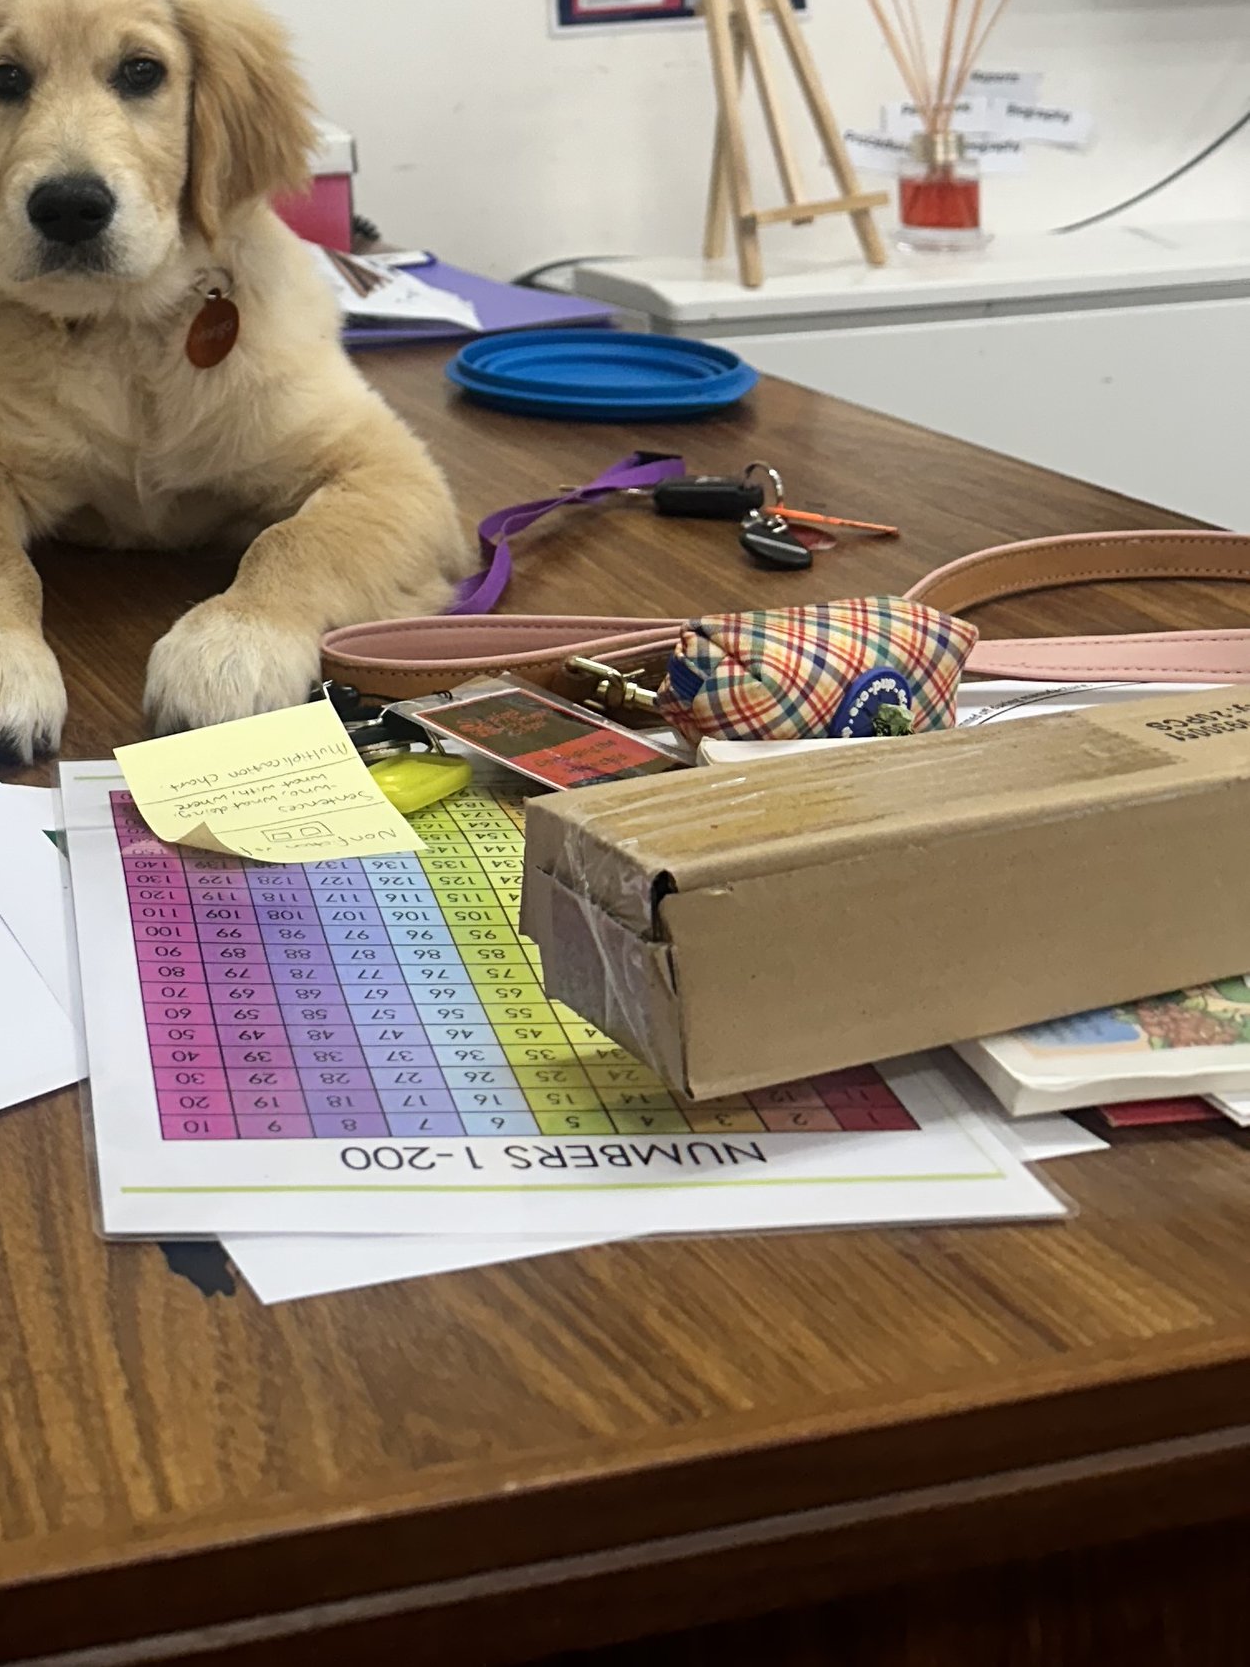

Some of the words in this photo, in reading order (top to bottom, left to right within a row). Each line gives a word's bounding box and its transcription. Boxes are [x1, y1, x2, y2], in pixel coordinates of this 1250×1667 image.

[228, 742, 348, 779] Multiplication
[282, 773, 328, 787] what
[174, 793, 227, 811] where
[233, 796, 278, 810] what
[278, 790, 375, 813] Sentences
[146, 927, 181, 937] 100
[216, 929, 242, 938] 99
[279, 929, 305, 939] 98
[345, 930, 369, 939] 97
[406, 930, 433, 940] 96
[469, 930, 496, 939] 95
[155, 947, 181, 956] 90
[220, 948, 246, 958] 89
[284, 949, 310, 959] 88
[351, 950, 375, 959] 87
[414, 950, 440, 959] 86
[478, 949, 505, 959] 85
[158, 967, 185, 977] 80
[225, 968, 249, 978] 79
[290, 969, 314, 979] 78
[358, 969, 382, 979] 77
[422, 969, 448, 978] 76
[487, 969, 514, 978] 75
[162, 987, 187, 998] 70
[229, 989, 254, 999] 69
[295, 989, 321, 999] 68
[365, 989, 388, 999] 67
[430, 989, 455, 998] 66
[496, 988, 522, 998] 65
[165, 1008, 191, 1019] 60
[234, 1009, 259, 1019] 59
[302, 1009, 327, 1019] 58
[372, 1009, 395, 1019] 57
[438, 1009, 463, 1019] 56
[505, 1008, 531, 1018] 55
[168, 1030, 195, 1040] 50
[239, 1030, 265, 1040] 49
[307, 1030, 334, 1040] 48
[379, 1030, 403, 1040] 47
[446, 1030, 473, 1039] 46
[515, 1029, 542, 1038] 45
[172, 1051, 200, 1062] 40
[244, 1052, 271, 1062] 39
[313, 1051, 342, 1062] 38
[387, 1051, 413, 1061] 37
[455, 1050, 485, 1061] 36
[525, 1050, 559, 1064] 35
[176, 1073, 204, 1084] 30
[249, 1073, 277, 1084] 29
[320, 1073, 350, 1084] 28
[395, 1073, 422, 1083] 27
[464, 1072, 494, 1082] 26
[536, 1067, 569, 1082] 25
[180, 1097, 209, 1109] 20
[254, 1097, 279, 1108] 19
[327, 1096, 353, 1107] 18
[403, 1095, 427, 1106] 17
[474, 1094, 502, 1105] 16
[547, 1093, 575, 1105] 15
[184, 1121, 209, 1133] 10
[268, 1121, 281, 1132] 9
[341, 1119, 356, 1131] 8
[419, 1119, 430, 1130] 7
[491, 1118, 504, 1129] 6
[566, 1116, 580, 1128] 5
[504, 1140, 767, 1173] NUMBERS
